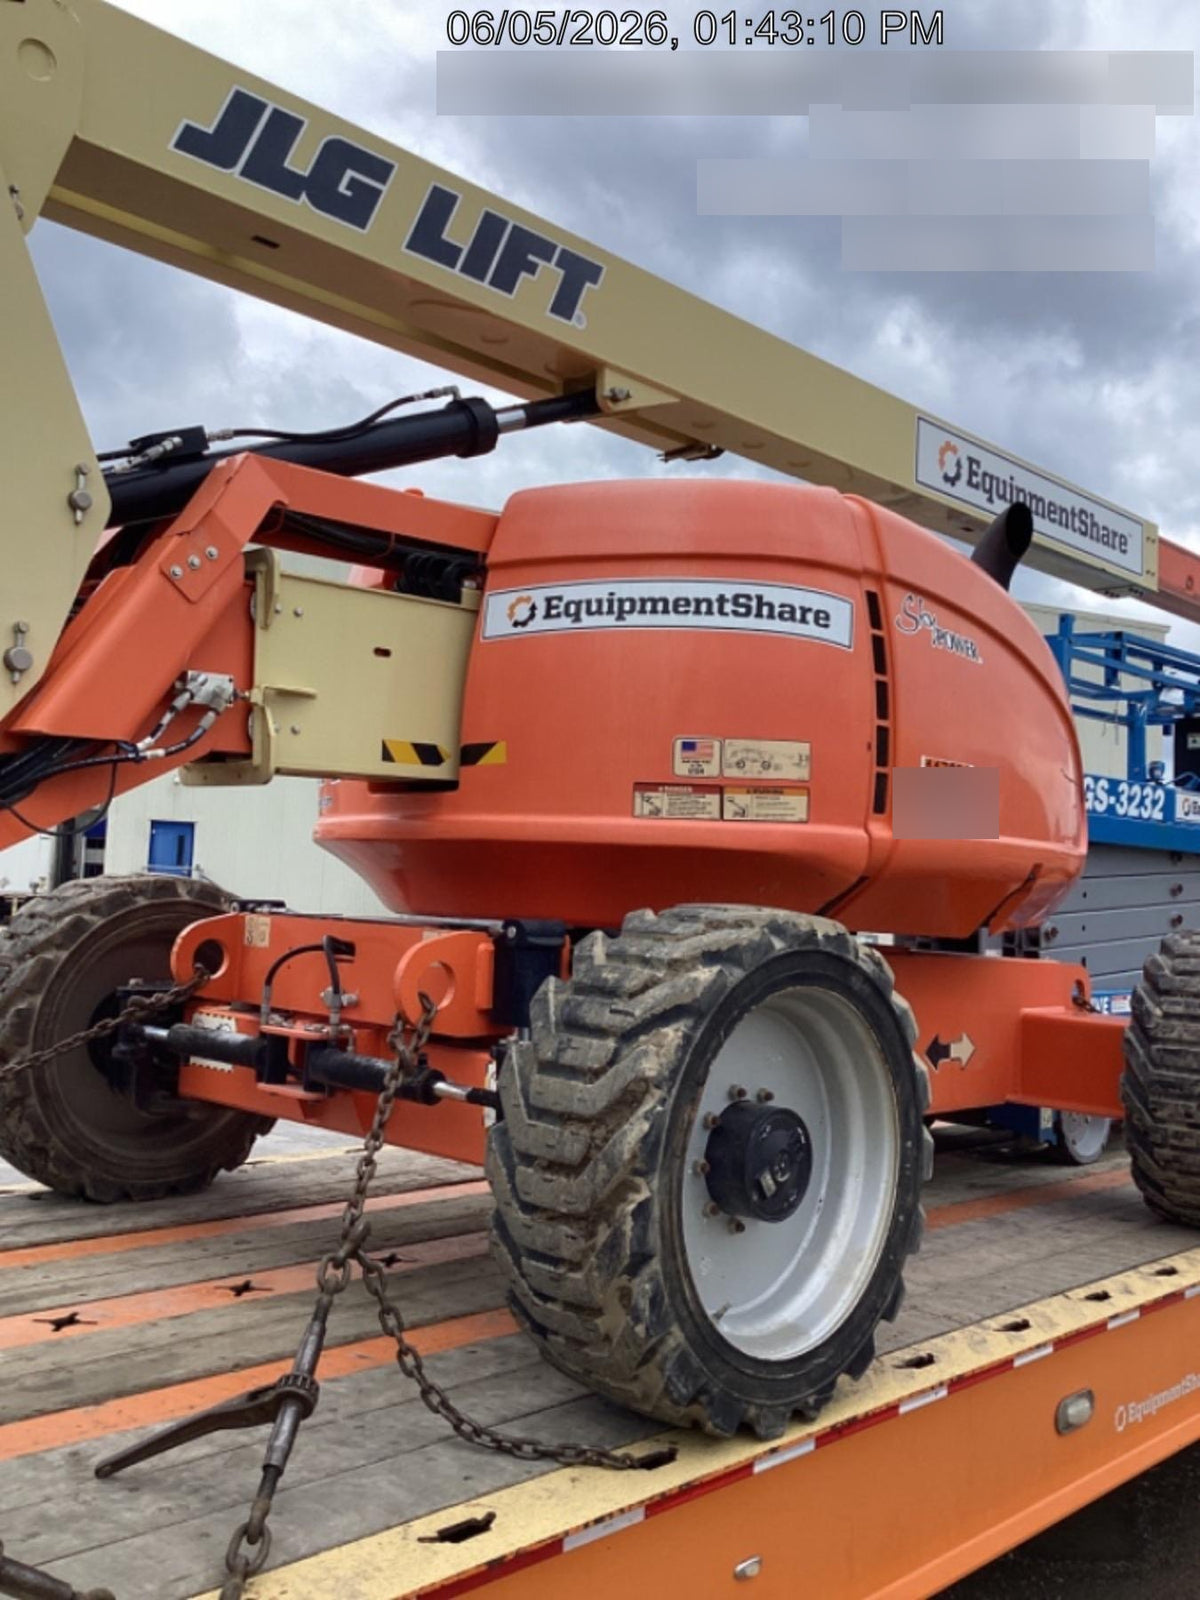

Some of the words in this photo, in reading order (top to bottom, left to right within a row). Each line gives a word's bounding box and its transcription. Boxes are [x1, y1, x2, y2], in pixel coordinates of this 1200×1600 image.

[170, 86, 398, 233] JLG
[404, 183, 605, 322] LIFT
[542, 591, 831, 628] EquipmentShare
[1084, 776, 1165, 820] GS-3232
